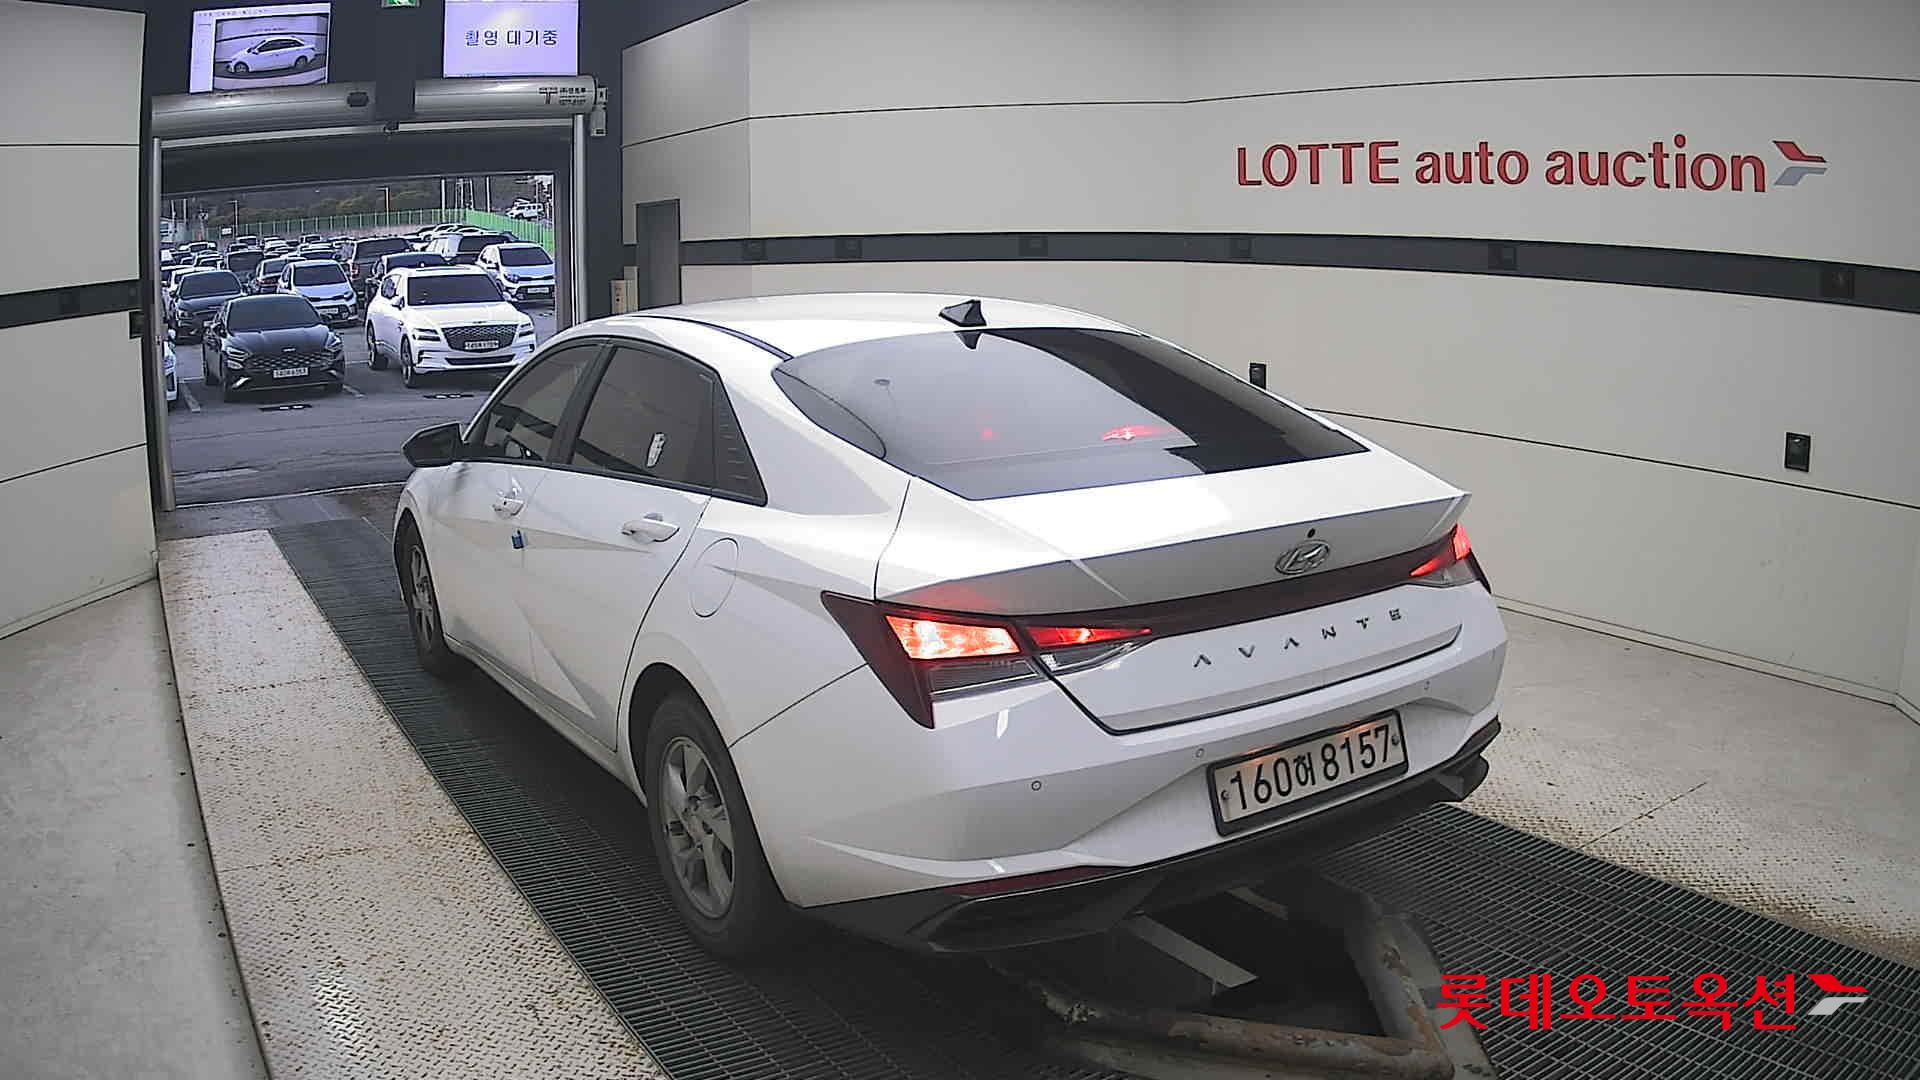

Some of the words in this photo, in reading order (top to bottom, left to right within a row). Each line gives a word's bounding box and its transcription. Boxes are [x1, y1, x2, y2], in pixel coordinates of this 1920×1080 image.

[506, 30, 558, 46] 대기중
[1237, 140, 1400, 188] LOTTE
[1415, 143, 1530, 186] auto
[1545, 134, 1768, 193] auction
[1193, 607, 1403, 669] AVANTE
